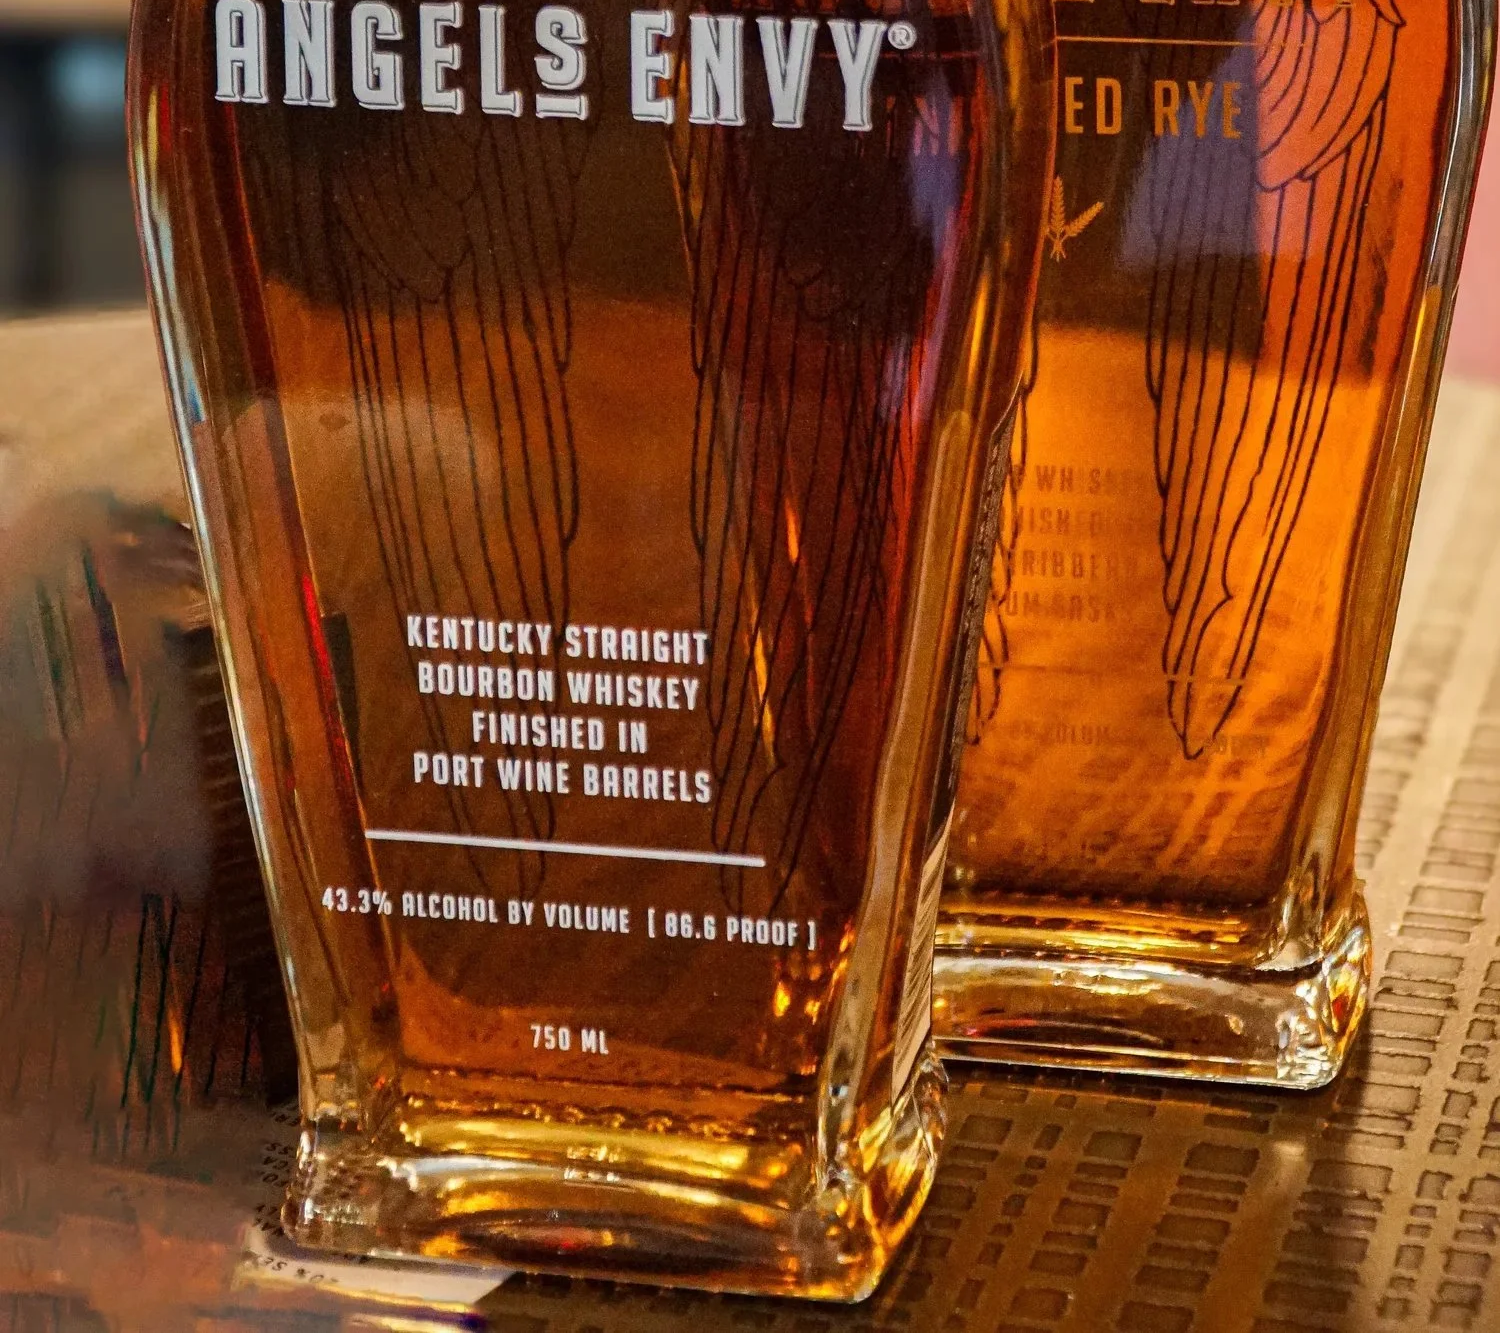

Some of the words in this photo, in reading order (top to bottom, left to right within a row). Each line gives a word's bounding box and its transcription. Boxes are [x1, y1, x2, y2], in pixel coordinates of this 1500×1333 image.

[1153, 79, 1243, 140] RYE
[406, 615, 552, 656] KENTUCKY
[565, 624, 708, 665] STRAIGHT
[418, 661, 554, 702] BOURBON
[566, 671, 699, 711] WHISKEY
[472, 710, 605, 751] FINISHED
[618, 720, 648, 754] IN
[413, 751, 485, 788] PORT
[496, 758, 570, 795] WINE
[583, 763, 711, 804] BARRELS
[321, 886, 393, 916] 43.3%
[401, 891, 499, 924] ALCOHOL
[507, 898, 534, 927] BY
[543, 902, 630, 935] VOLUME
[530, 1024, 571, 1052] 750
[580, 1028, 610, 1055] ML
